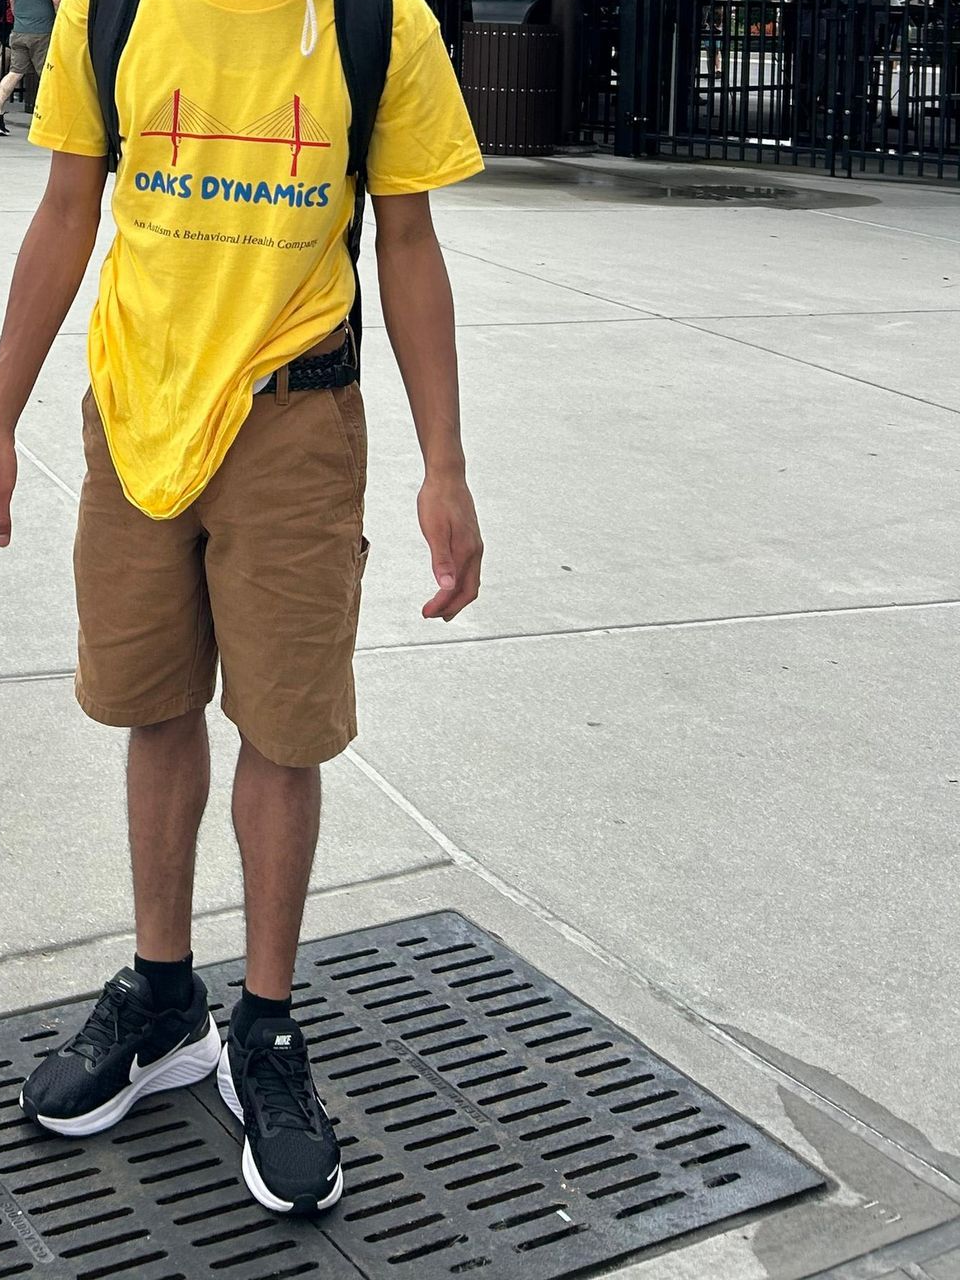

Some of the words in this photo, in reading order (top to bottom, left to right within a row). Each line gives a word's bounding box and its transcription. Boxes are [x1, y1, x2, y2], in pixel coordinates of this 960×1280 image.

[135, 170, 193, 199] OAKS
[134, 219, 145, 228] An
[173, 229, 180, 238] &
[183, 230, 241, 245] Behavioral
[242, 235, 275, 248] Health
[274, 1034, 292, 1046] NIKE
